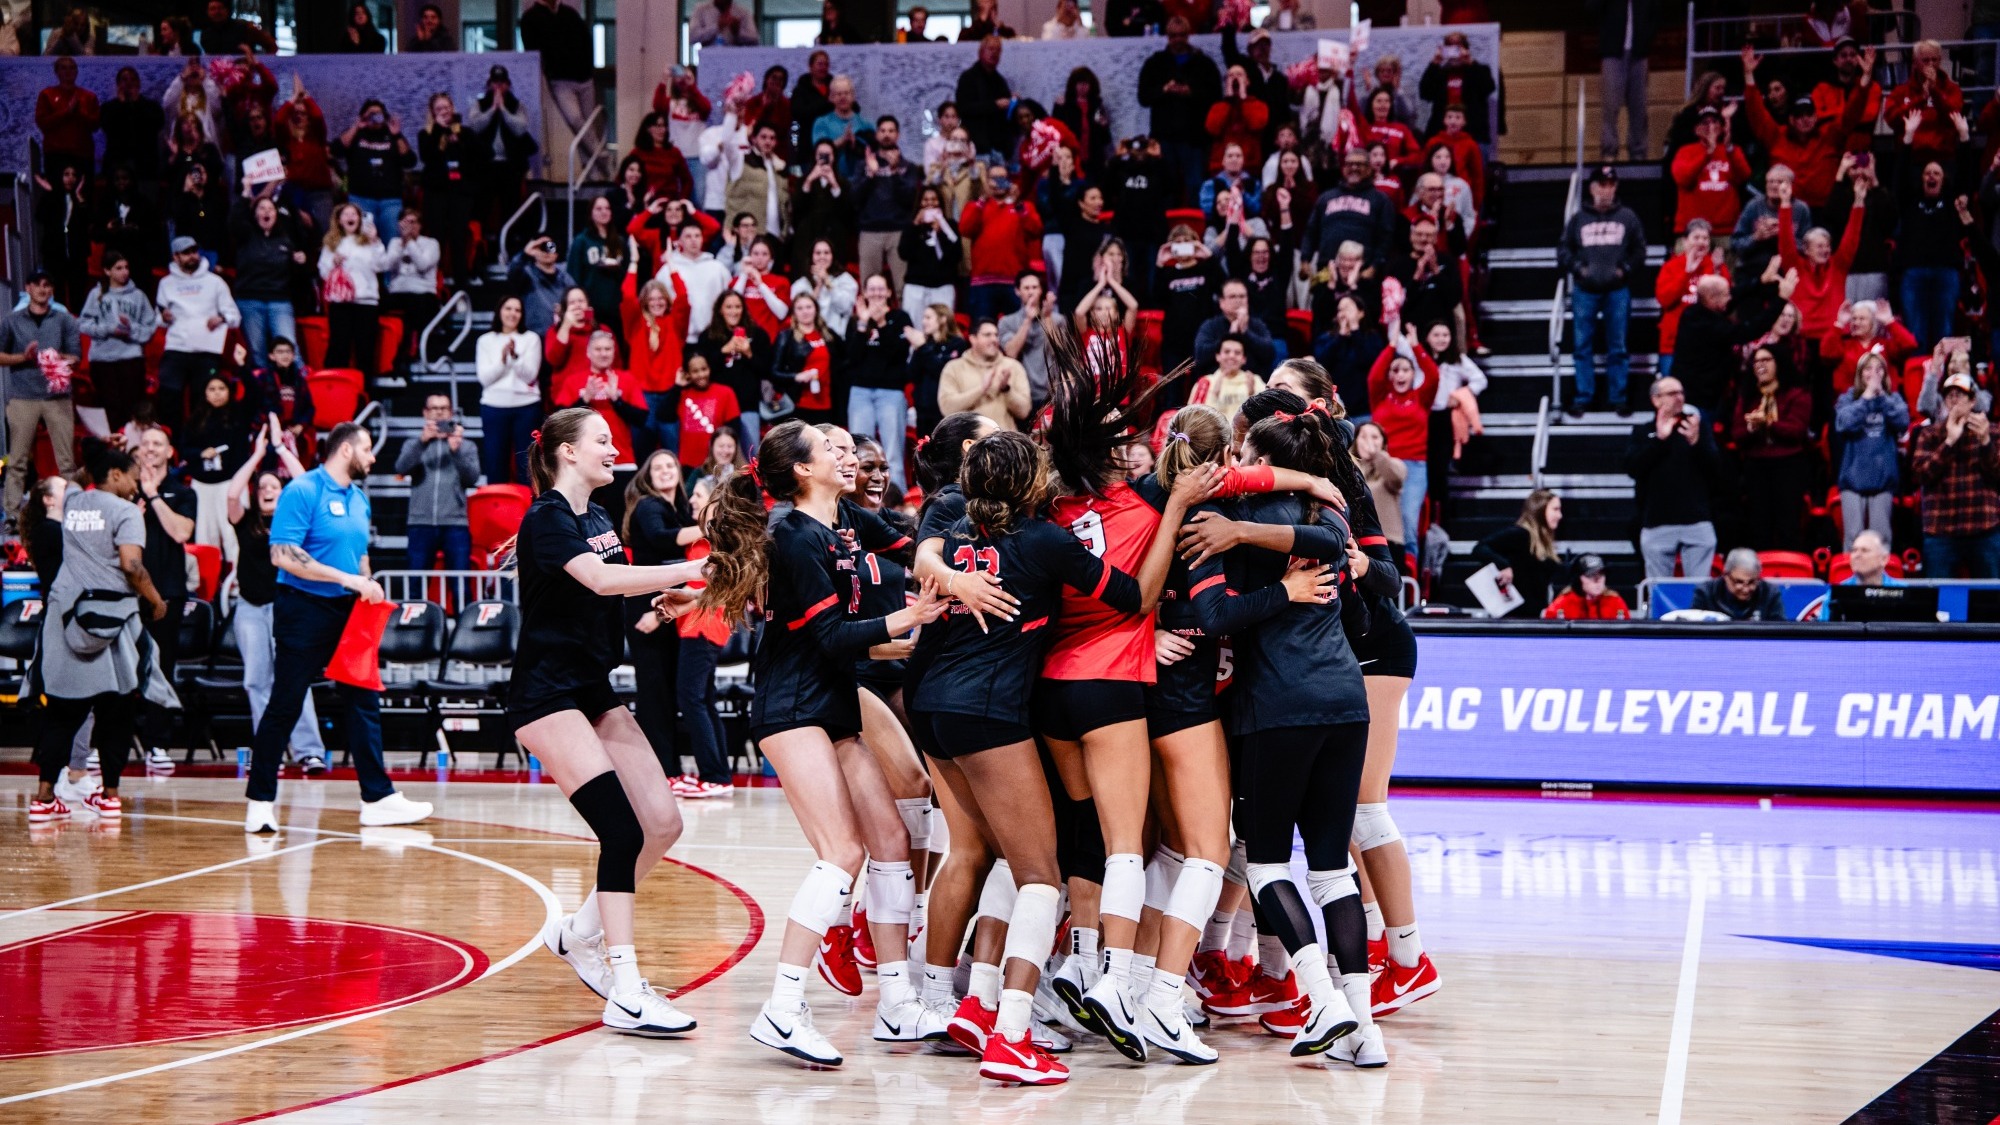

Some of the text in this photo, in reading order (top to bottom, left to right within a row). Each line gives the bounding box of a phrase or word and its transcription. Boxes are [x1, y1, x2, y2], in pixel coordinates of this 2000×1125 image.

[586, 529, 621, 552] STAG
[1070, 508, 1108, 559] 9
[865, 552, 882, 585] 1
[1215, 646, 1234, 682] 5
[1499, 686, 1817, 737] VOLLEYBALL
[1835, 691, 2000, 740] CHAM
